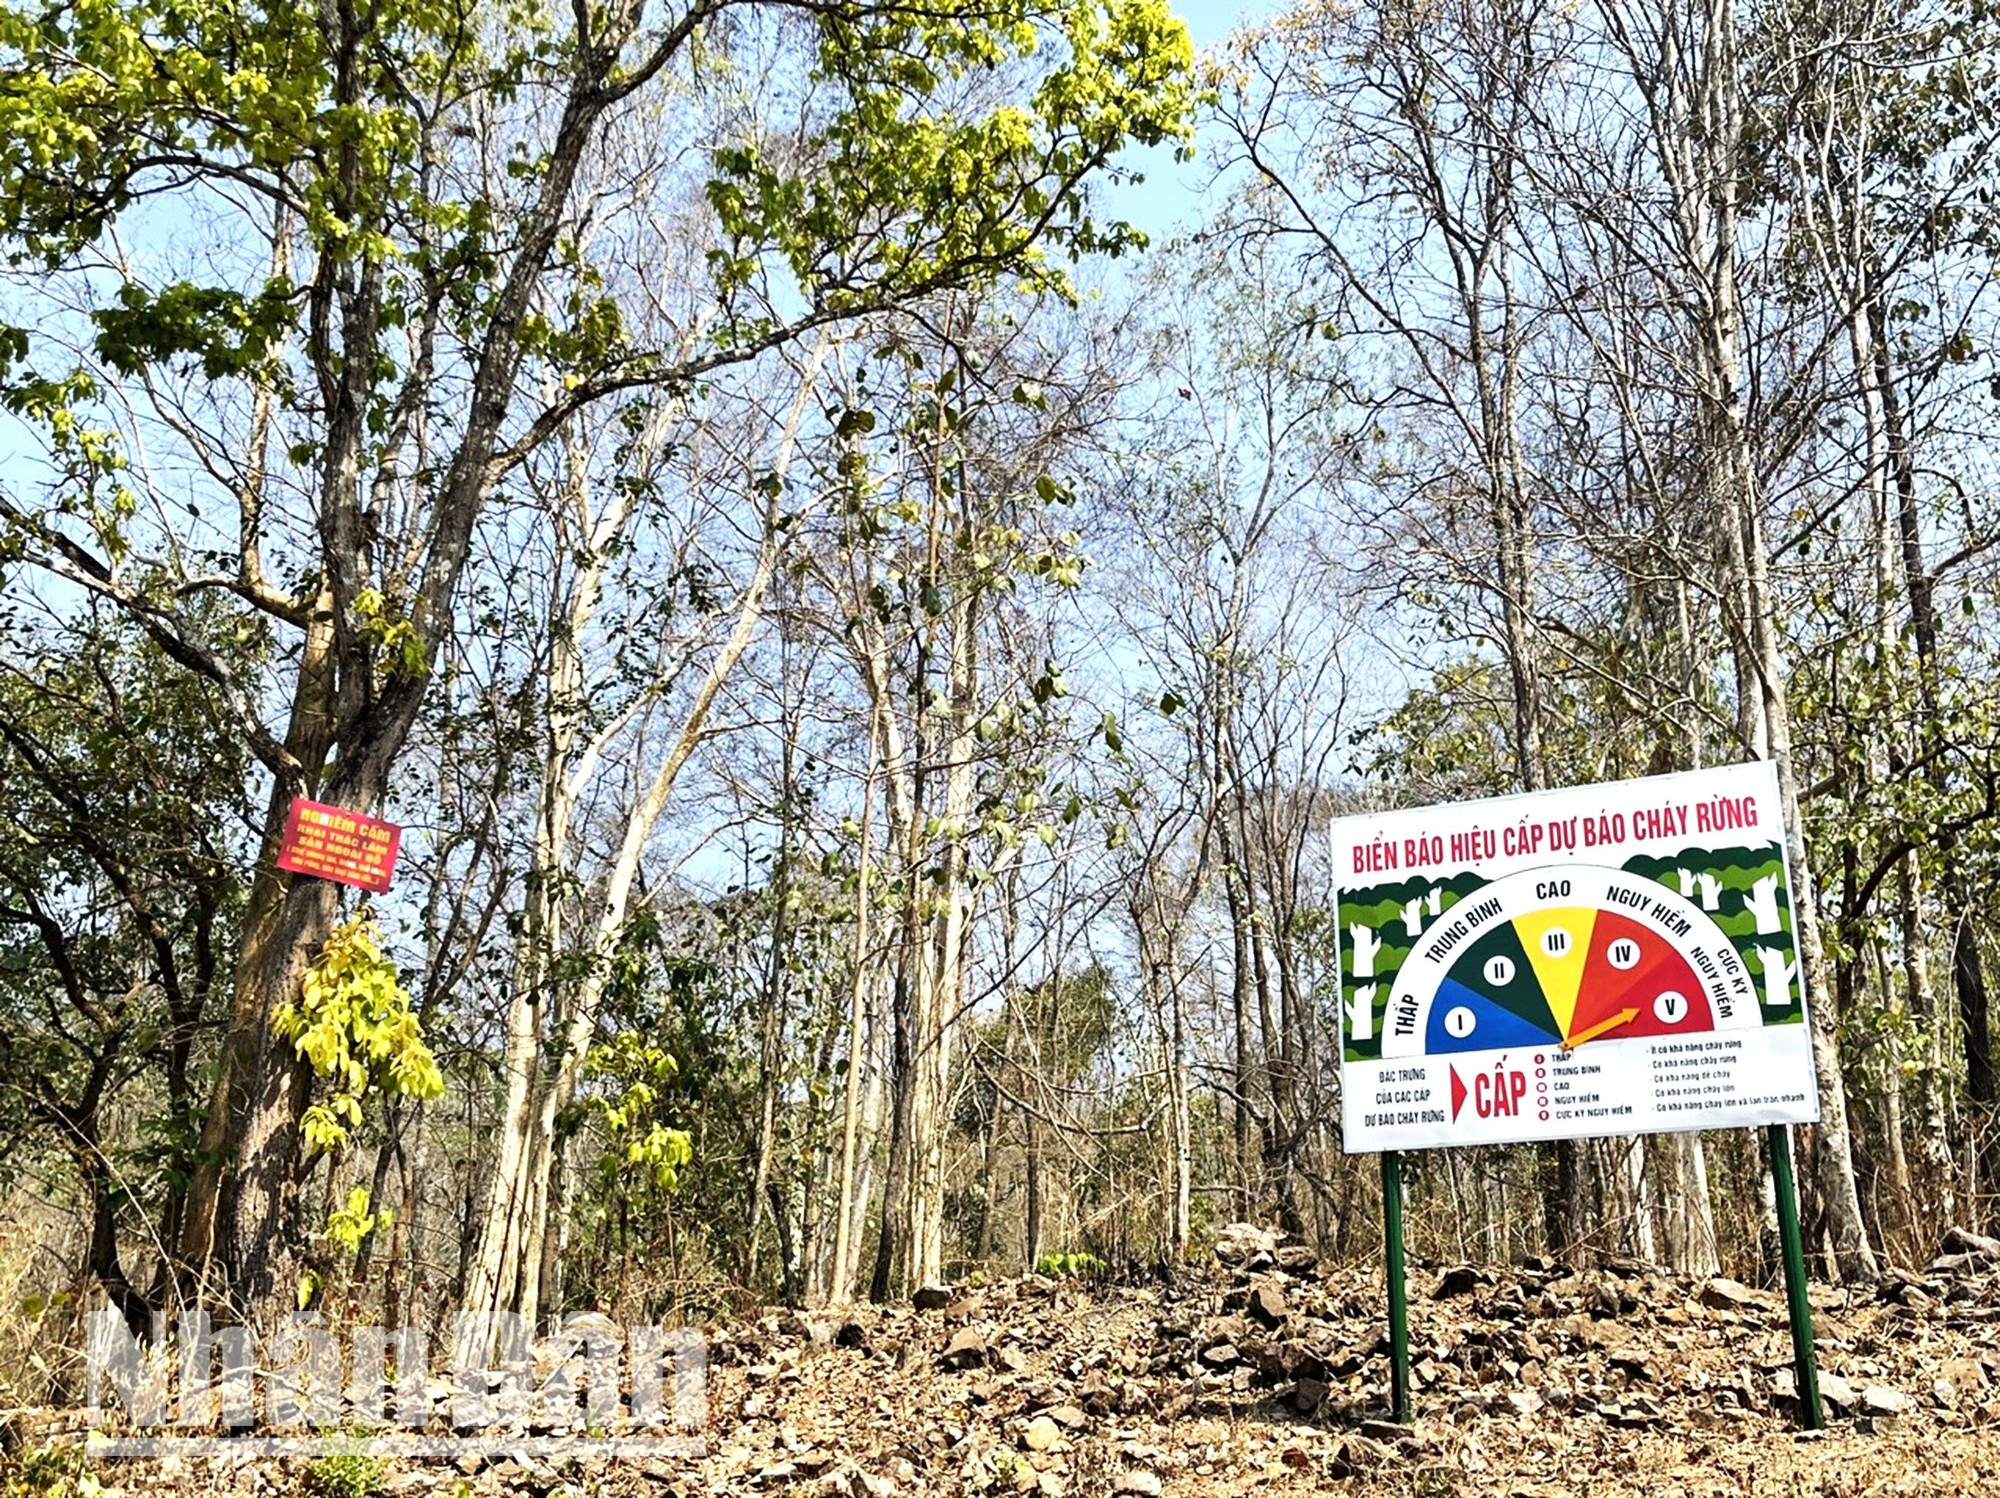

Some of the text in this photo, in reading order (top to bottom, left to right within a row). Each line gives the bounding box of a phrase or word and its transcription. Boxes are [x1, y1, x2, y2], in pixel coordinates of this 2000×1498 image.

[300, 808, 391, 843] NGHIÊM CẤM
[1353, 794, 1758, 874] BIỂN BÁO HIỆU CẤP DỰ BÁO CHÁY RỪNG
[1536, 880, 1571, 900] CAO
[1606, 885, 1692, 937] NGUY HIỂM
[1424, 898, 1503, 964] TRUNG BÌNH
[1548, 933, 1565, 951] III
[1615, 945, 1631, 963] IV
[1717, 948, 1739, 975] CỰC
[1494, 963, 1504, 979] II
[1690, 946, 1736, 1019] NGUY HIỂM
[1393, 994, 1419, 1036] THẤP
[1665, 998, 1676, 1016] V
[1458, 1014, 1462, 1031] I
[1474, 1054, 1527, 1119] CẤP
[1554, 1082, 1570, 1091] CAO
